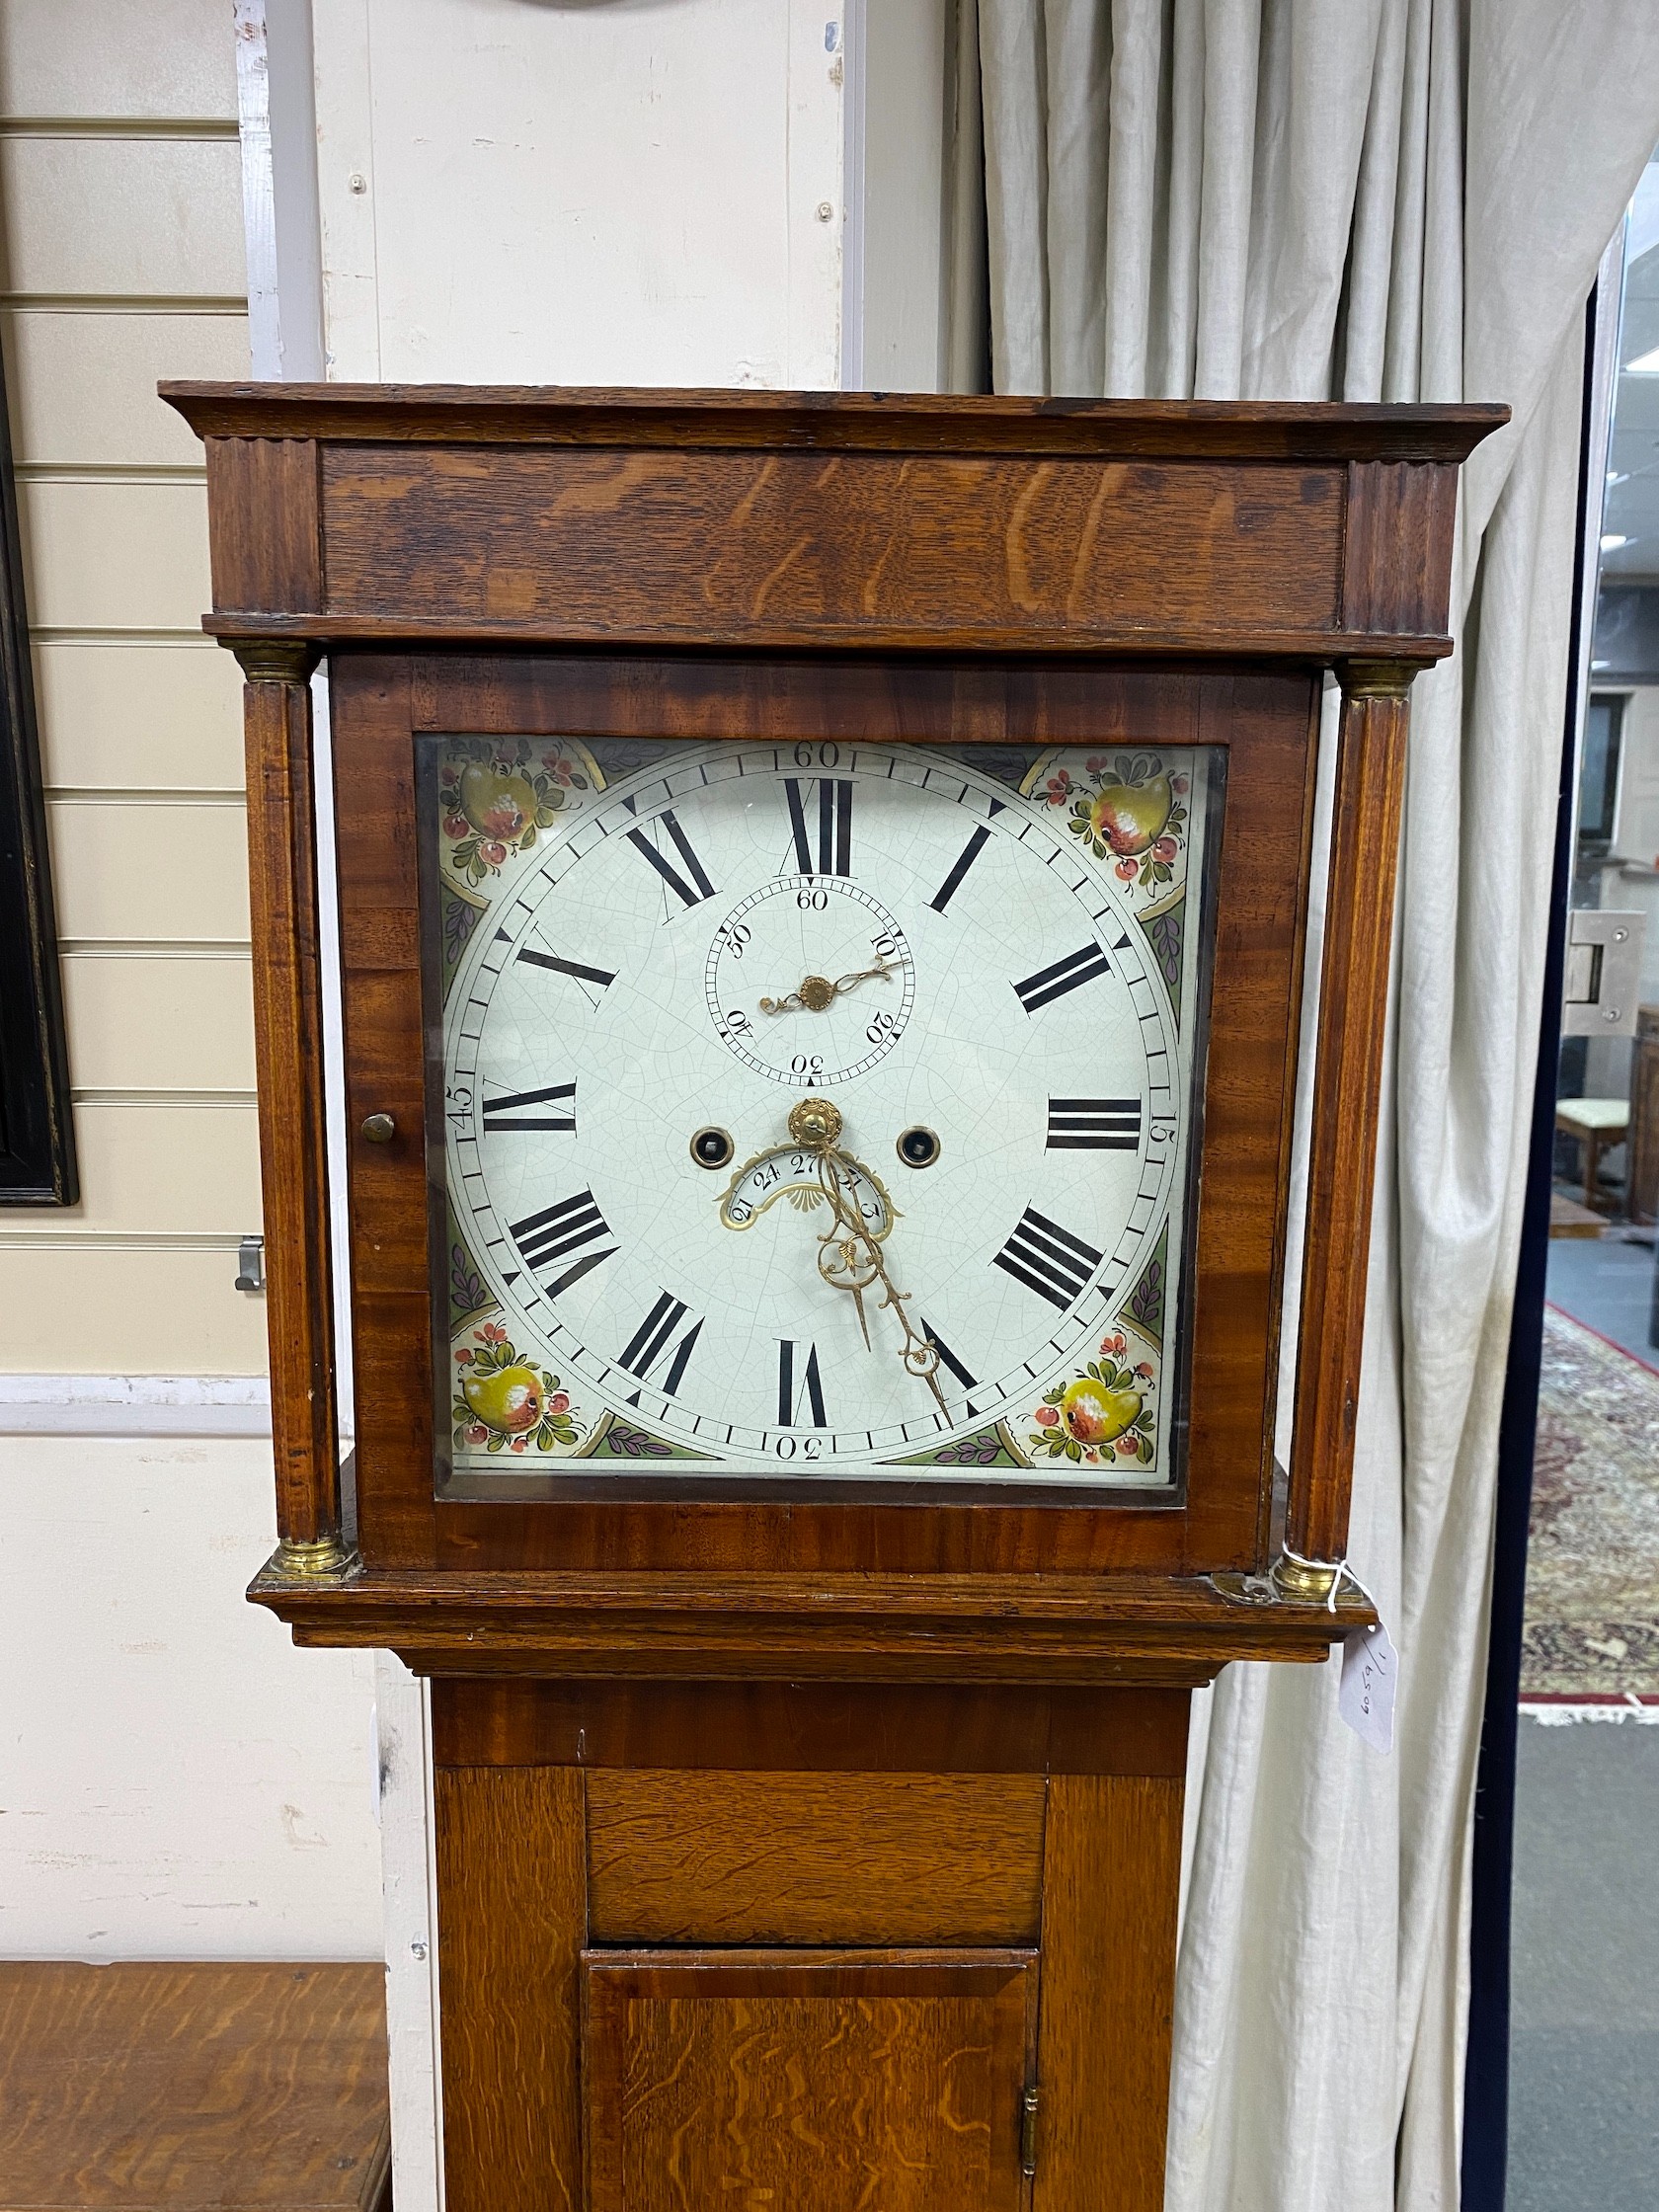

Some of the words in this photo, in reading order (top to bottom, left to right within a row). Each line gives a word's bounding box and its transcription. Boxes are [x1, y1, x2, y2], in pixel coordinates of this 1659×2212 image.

[794, 741, 840, 768] 60
[772, 777, 860, 880] XII
[618, 804, 723, 926] XI
[922, 820, 998, 918] I
[797, 890, 829, 911] 60
[726, 924, 752, 960] 50
[869, 926, 897, 958] 10
[513, 920, 621, 1014] X
[1008, 933, 1116, 1020] II
[726, 1010, 754, 1040] 40
[866, 1011, 895, 1045] 20
[791, 1054, 825, 1075] 30
[445, 1085, 473, 1130] 45
[482, 1074, 579, 1140] IX
[1044, 1091, 1143, 1156] III
[1149, 1110, 1177, 1144] 15
[752, 1163, 782, 1192] 24
[790, 1154, 819, 1175] 27
[731, 1198, 754, 1223] 21
[504, 1181, 622, 1305] VIII
[988, 1198, 1108, 1319] IIII
[609, 1285, 706, 1400] VII
[919, 1315, 986, 1402] V
[771, 1337, 835, 1428] VI
[776, 1436, 822, 1461] 30
